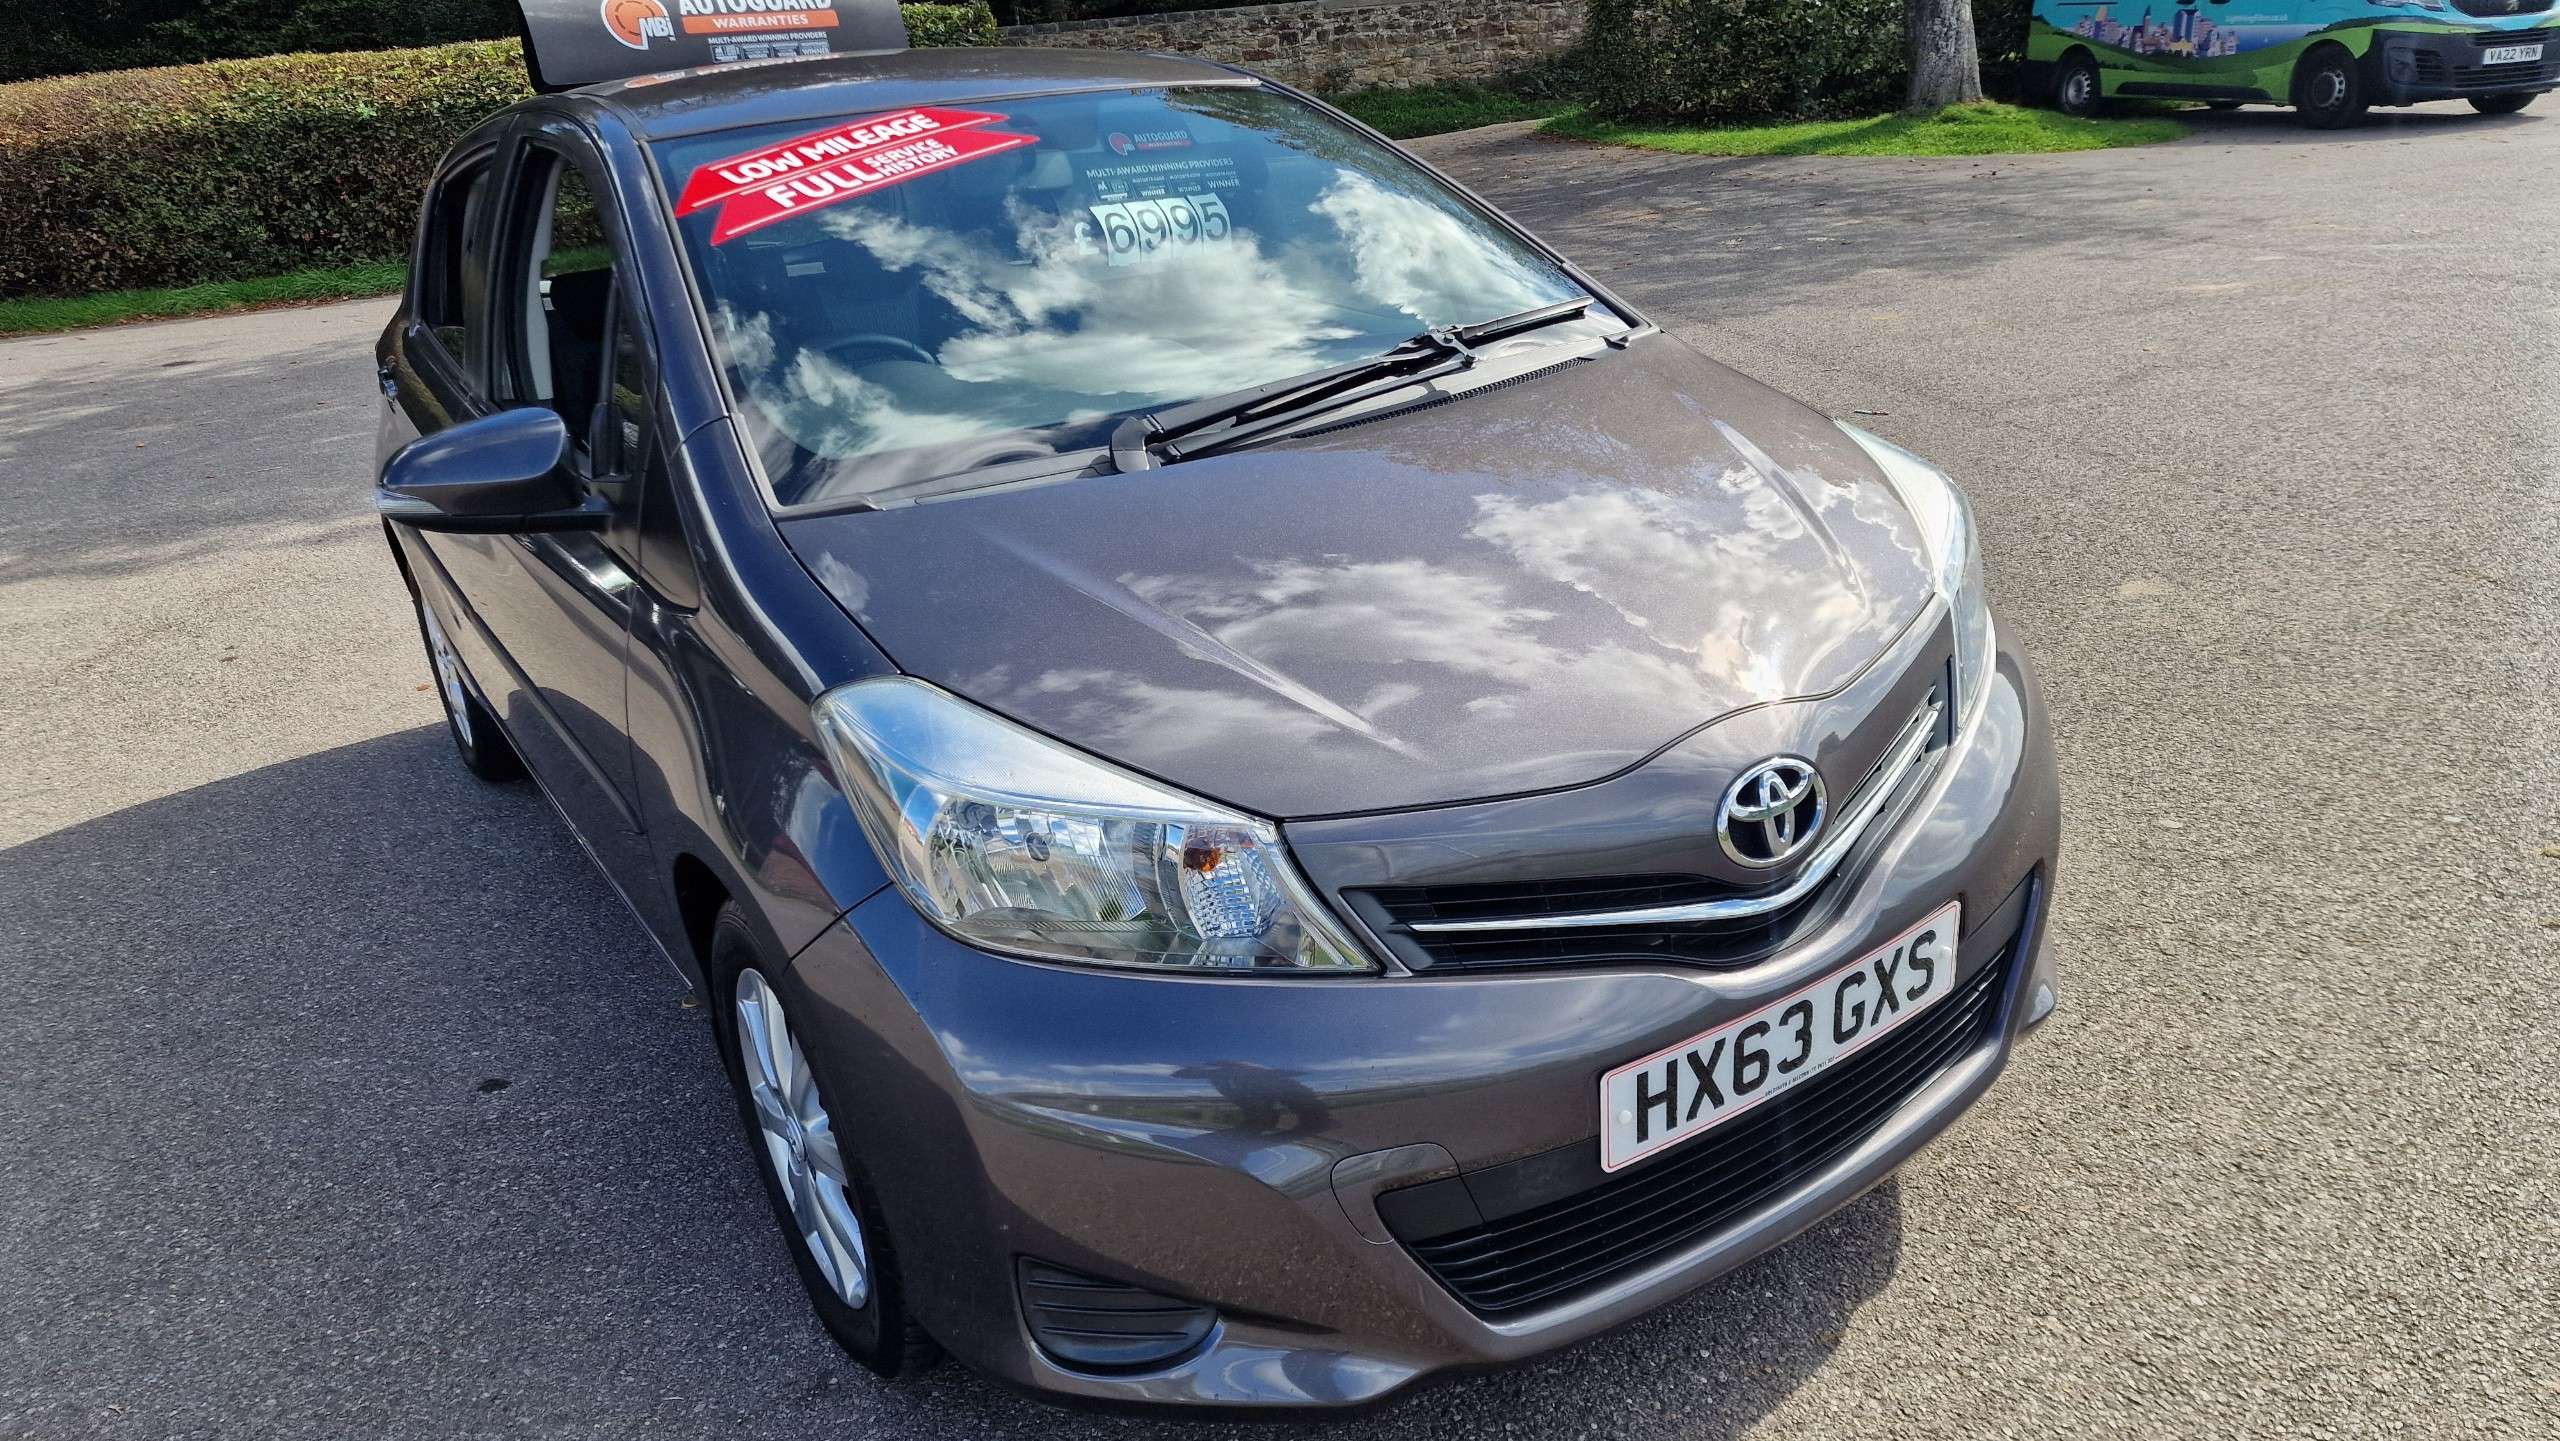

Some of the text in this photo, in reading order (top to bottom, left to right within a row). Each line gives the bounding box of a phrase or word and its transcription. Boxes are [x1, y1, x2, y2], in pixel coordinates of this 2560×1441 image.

[712, 14, 809, 29] WARRANTIES
[708, 31, 827, 45] MULTI-AWARD WINNING PROVIDERS
[2520, 47, 2538, 59] YRN
[1134, 130, 1188, 143] AUTOGUARD
[718, 113, 941, 185] LOW MILEAGE
[864, 138, 945, 168] SERVICE
[876, 145, 959, 178] HISTORY
[1086, 157, 1234, 178] MULTI-AWARD WINNING PROVIDERS
[765, 163, 883, 209] FULL
[1207, 178, 1240, 189] WINNER
[1636, 929, 1937, 1144] HX63 GXS
